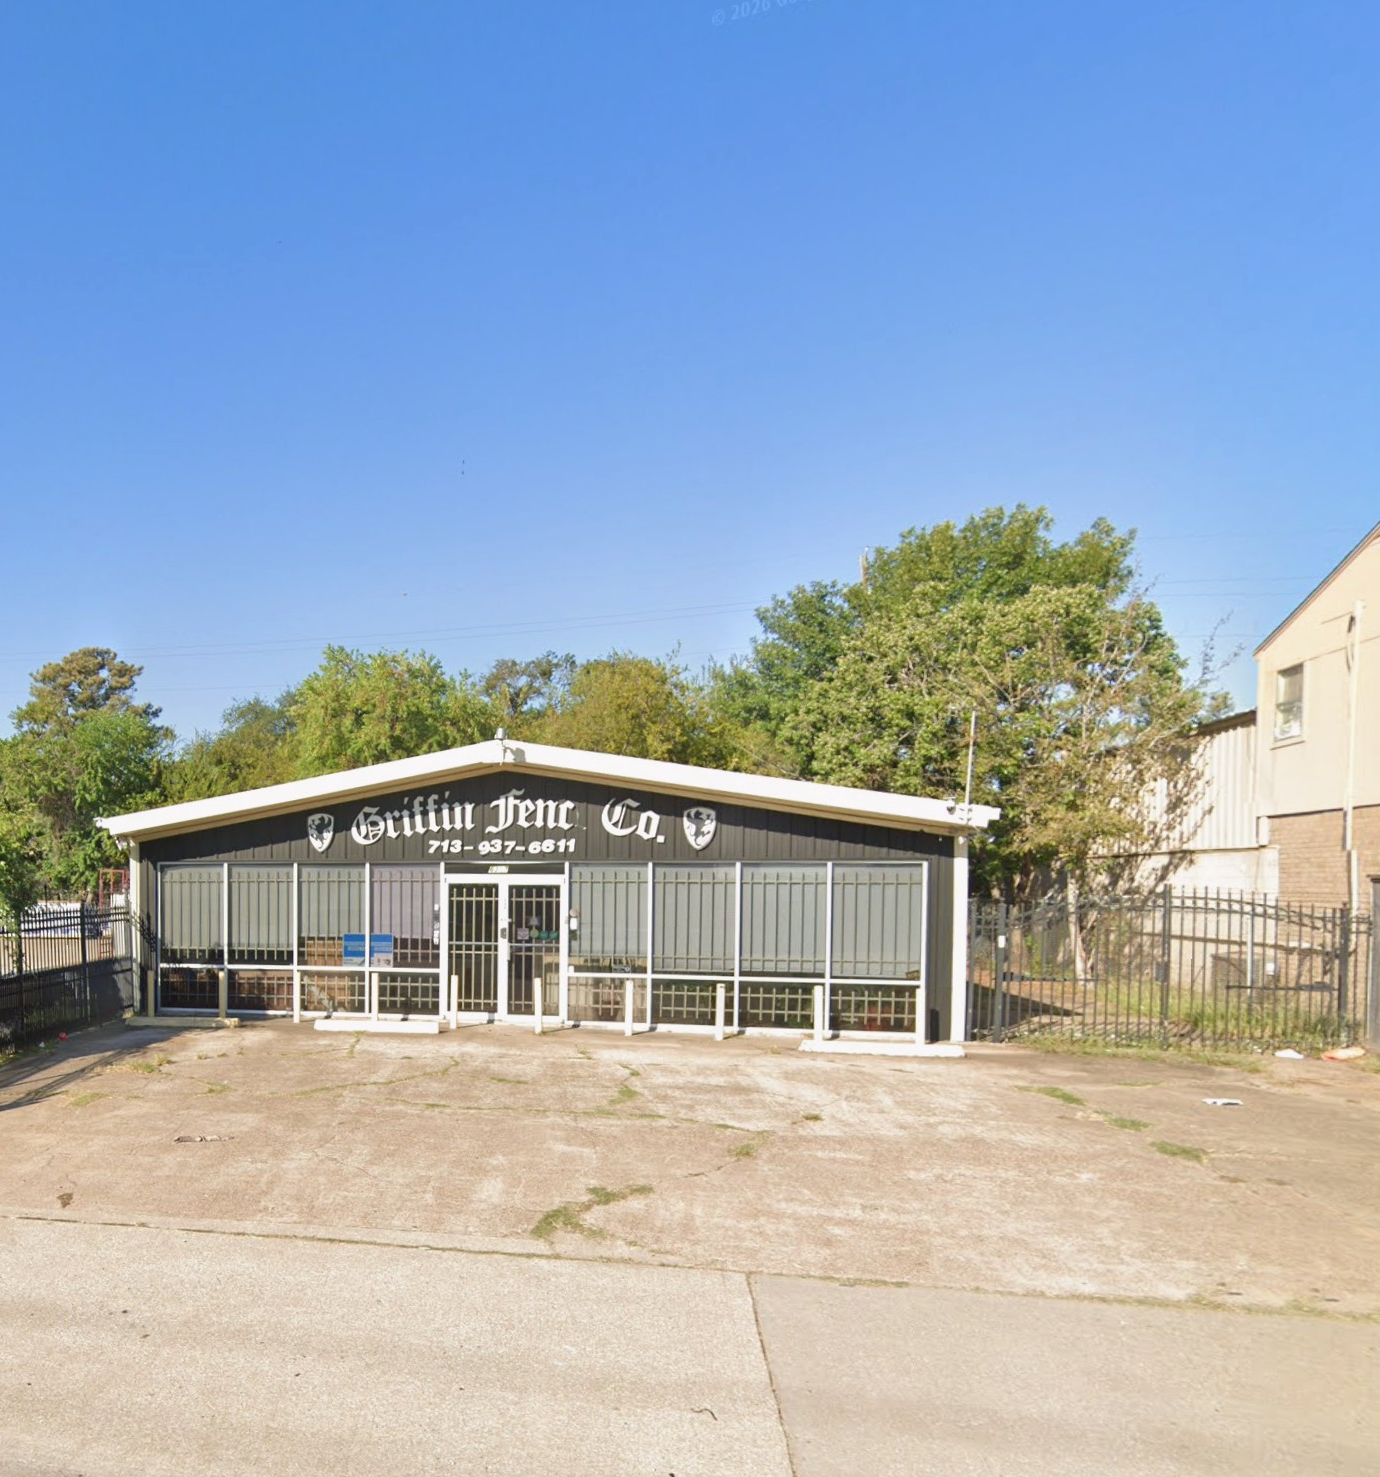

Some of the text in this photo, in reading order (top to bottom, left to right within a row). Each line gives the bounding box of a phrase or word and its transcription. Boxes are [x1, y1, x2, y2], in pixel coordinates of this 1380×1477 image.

[350, 788, 666, 845] Griffin Fenc Co.
